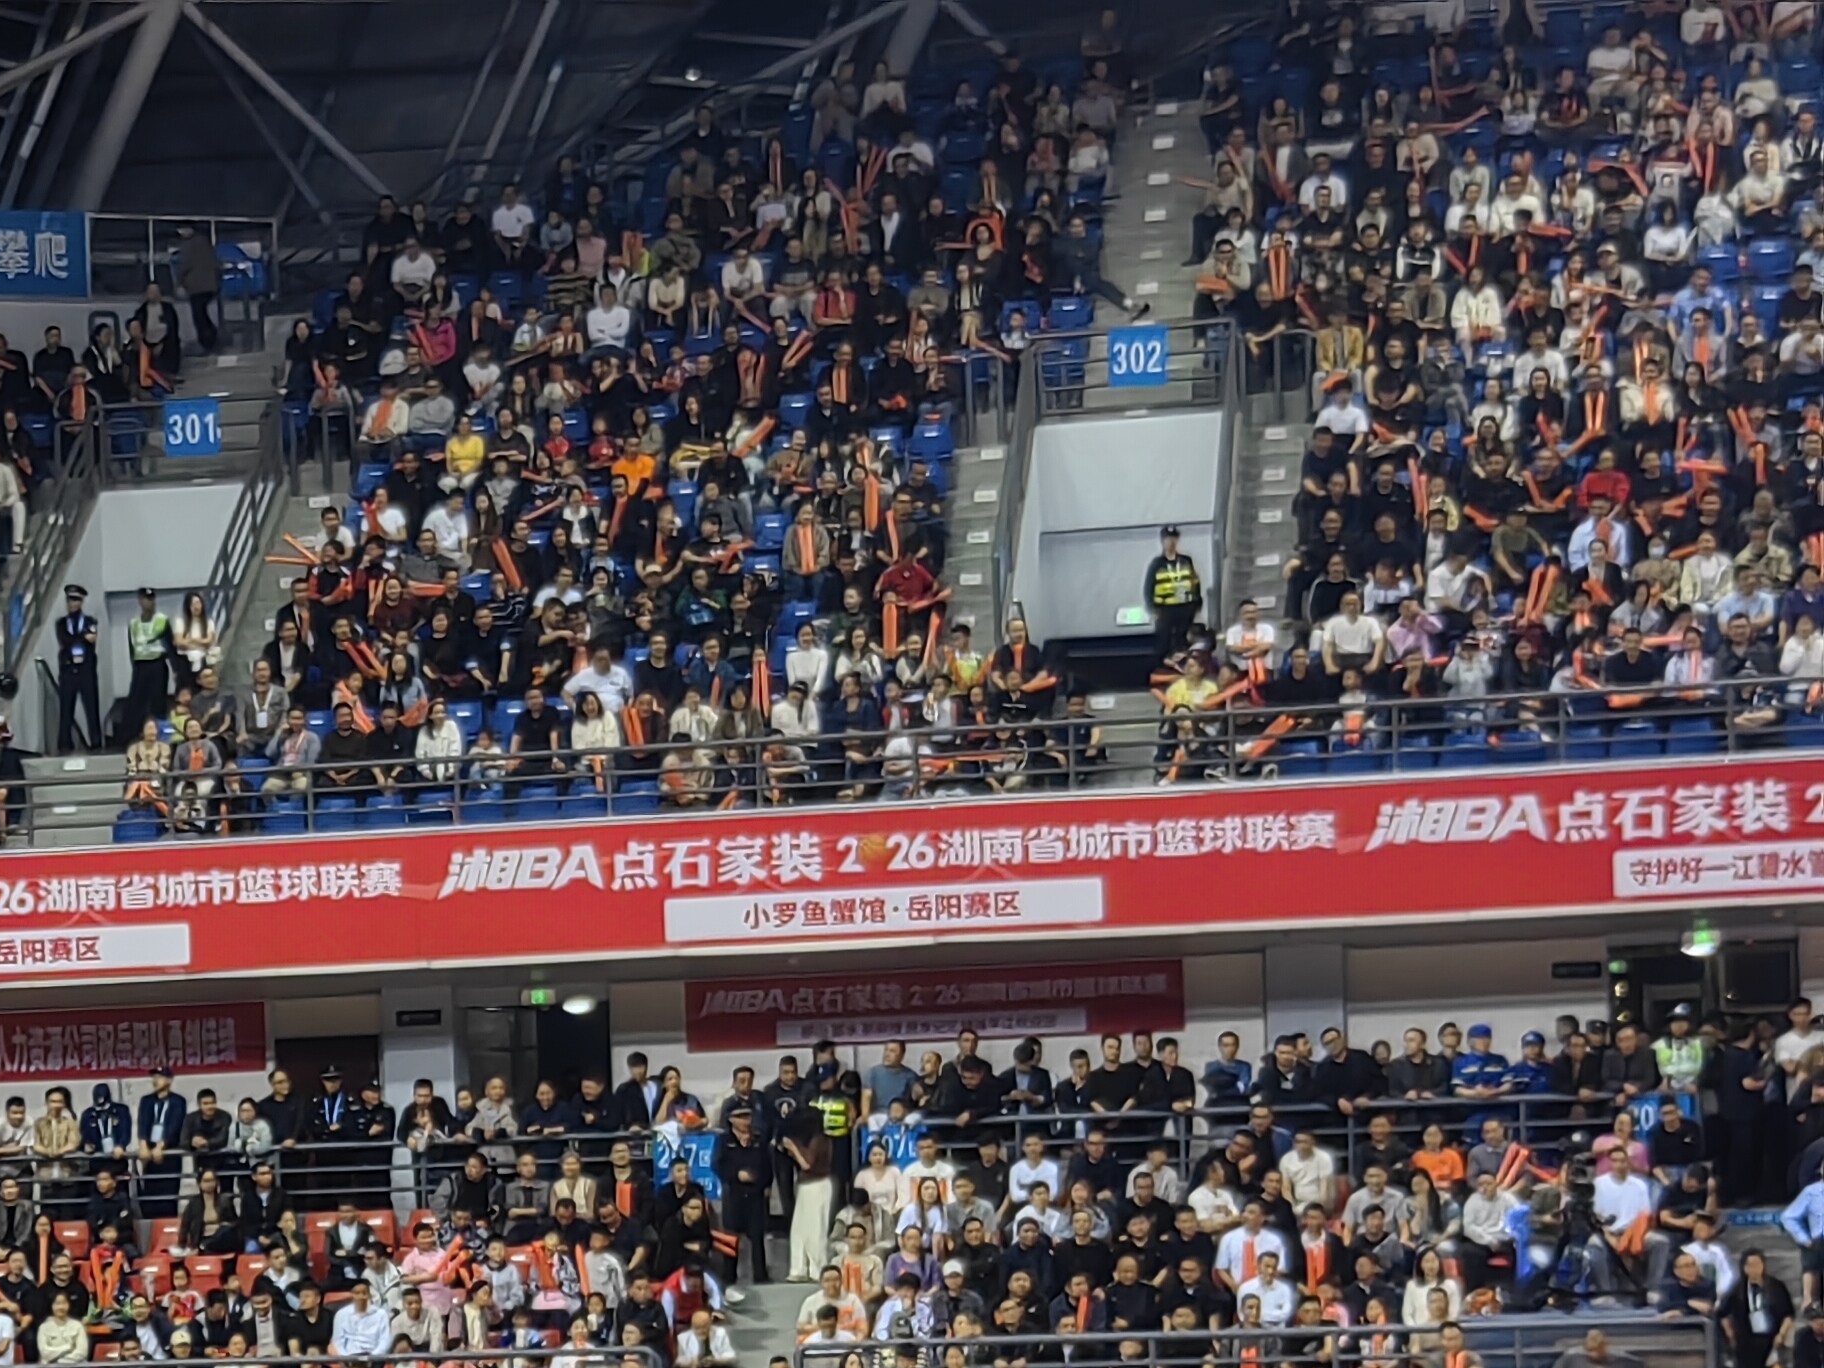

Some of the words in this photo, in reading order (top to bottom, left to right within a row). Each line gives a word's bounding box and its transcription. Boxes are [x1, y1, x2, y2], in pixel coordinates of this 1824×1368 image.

[1112, 341, 1164, 375] 302
[168, 413, 217, 446] 301
[1555, 778, 1790, 843] 点石家装
[610, 830, 824, 893] 点石家装
